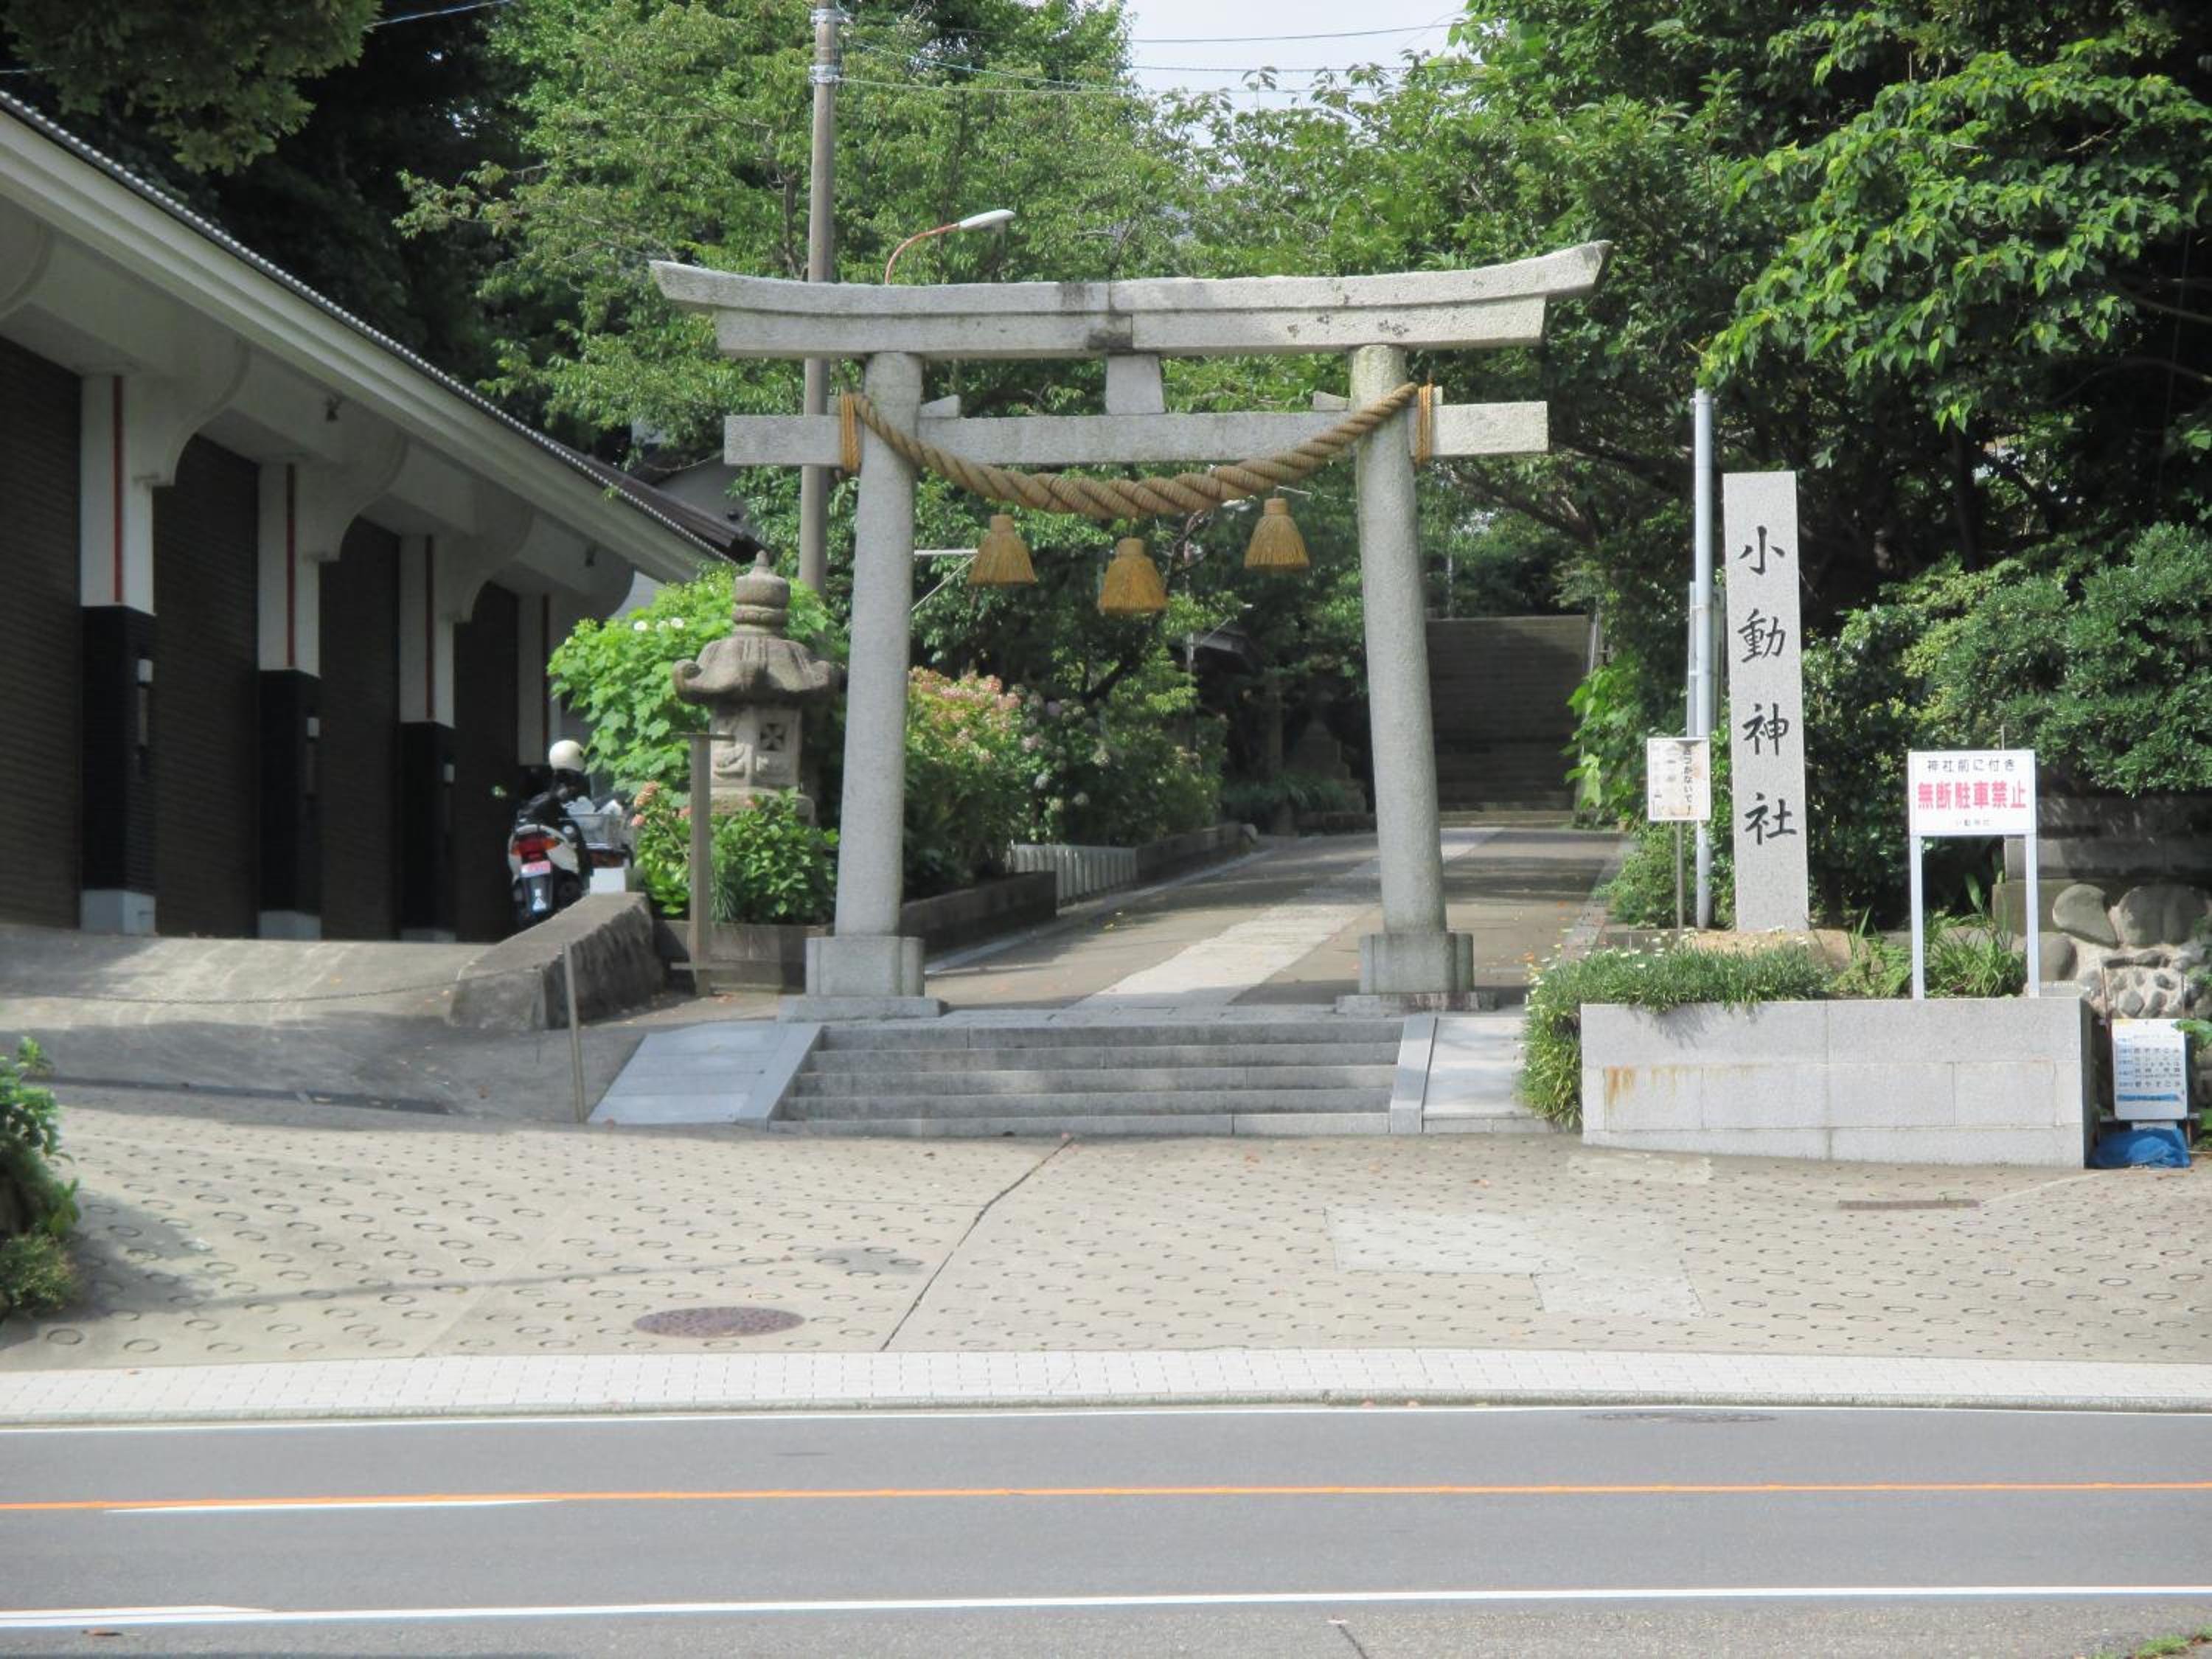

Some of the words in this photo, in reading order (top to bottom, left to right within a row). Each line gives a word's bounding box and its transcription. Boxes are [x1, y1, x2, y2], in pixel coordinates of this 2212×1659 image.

[1737, 525, 1798, 846] 小動神社
[1927, 759, 2016, 773] 神社前に付き
[1917, 780, 2026, 810] 無断駐車禁止
